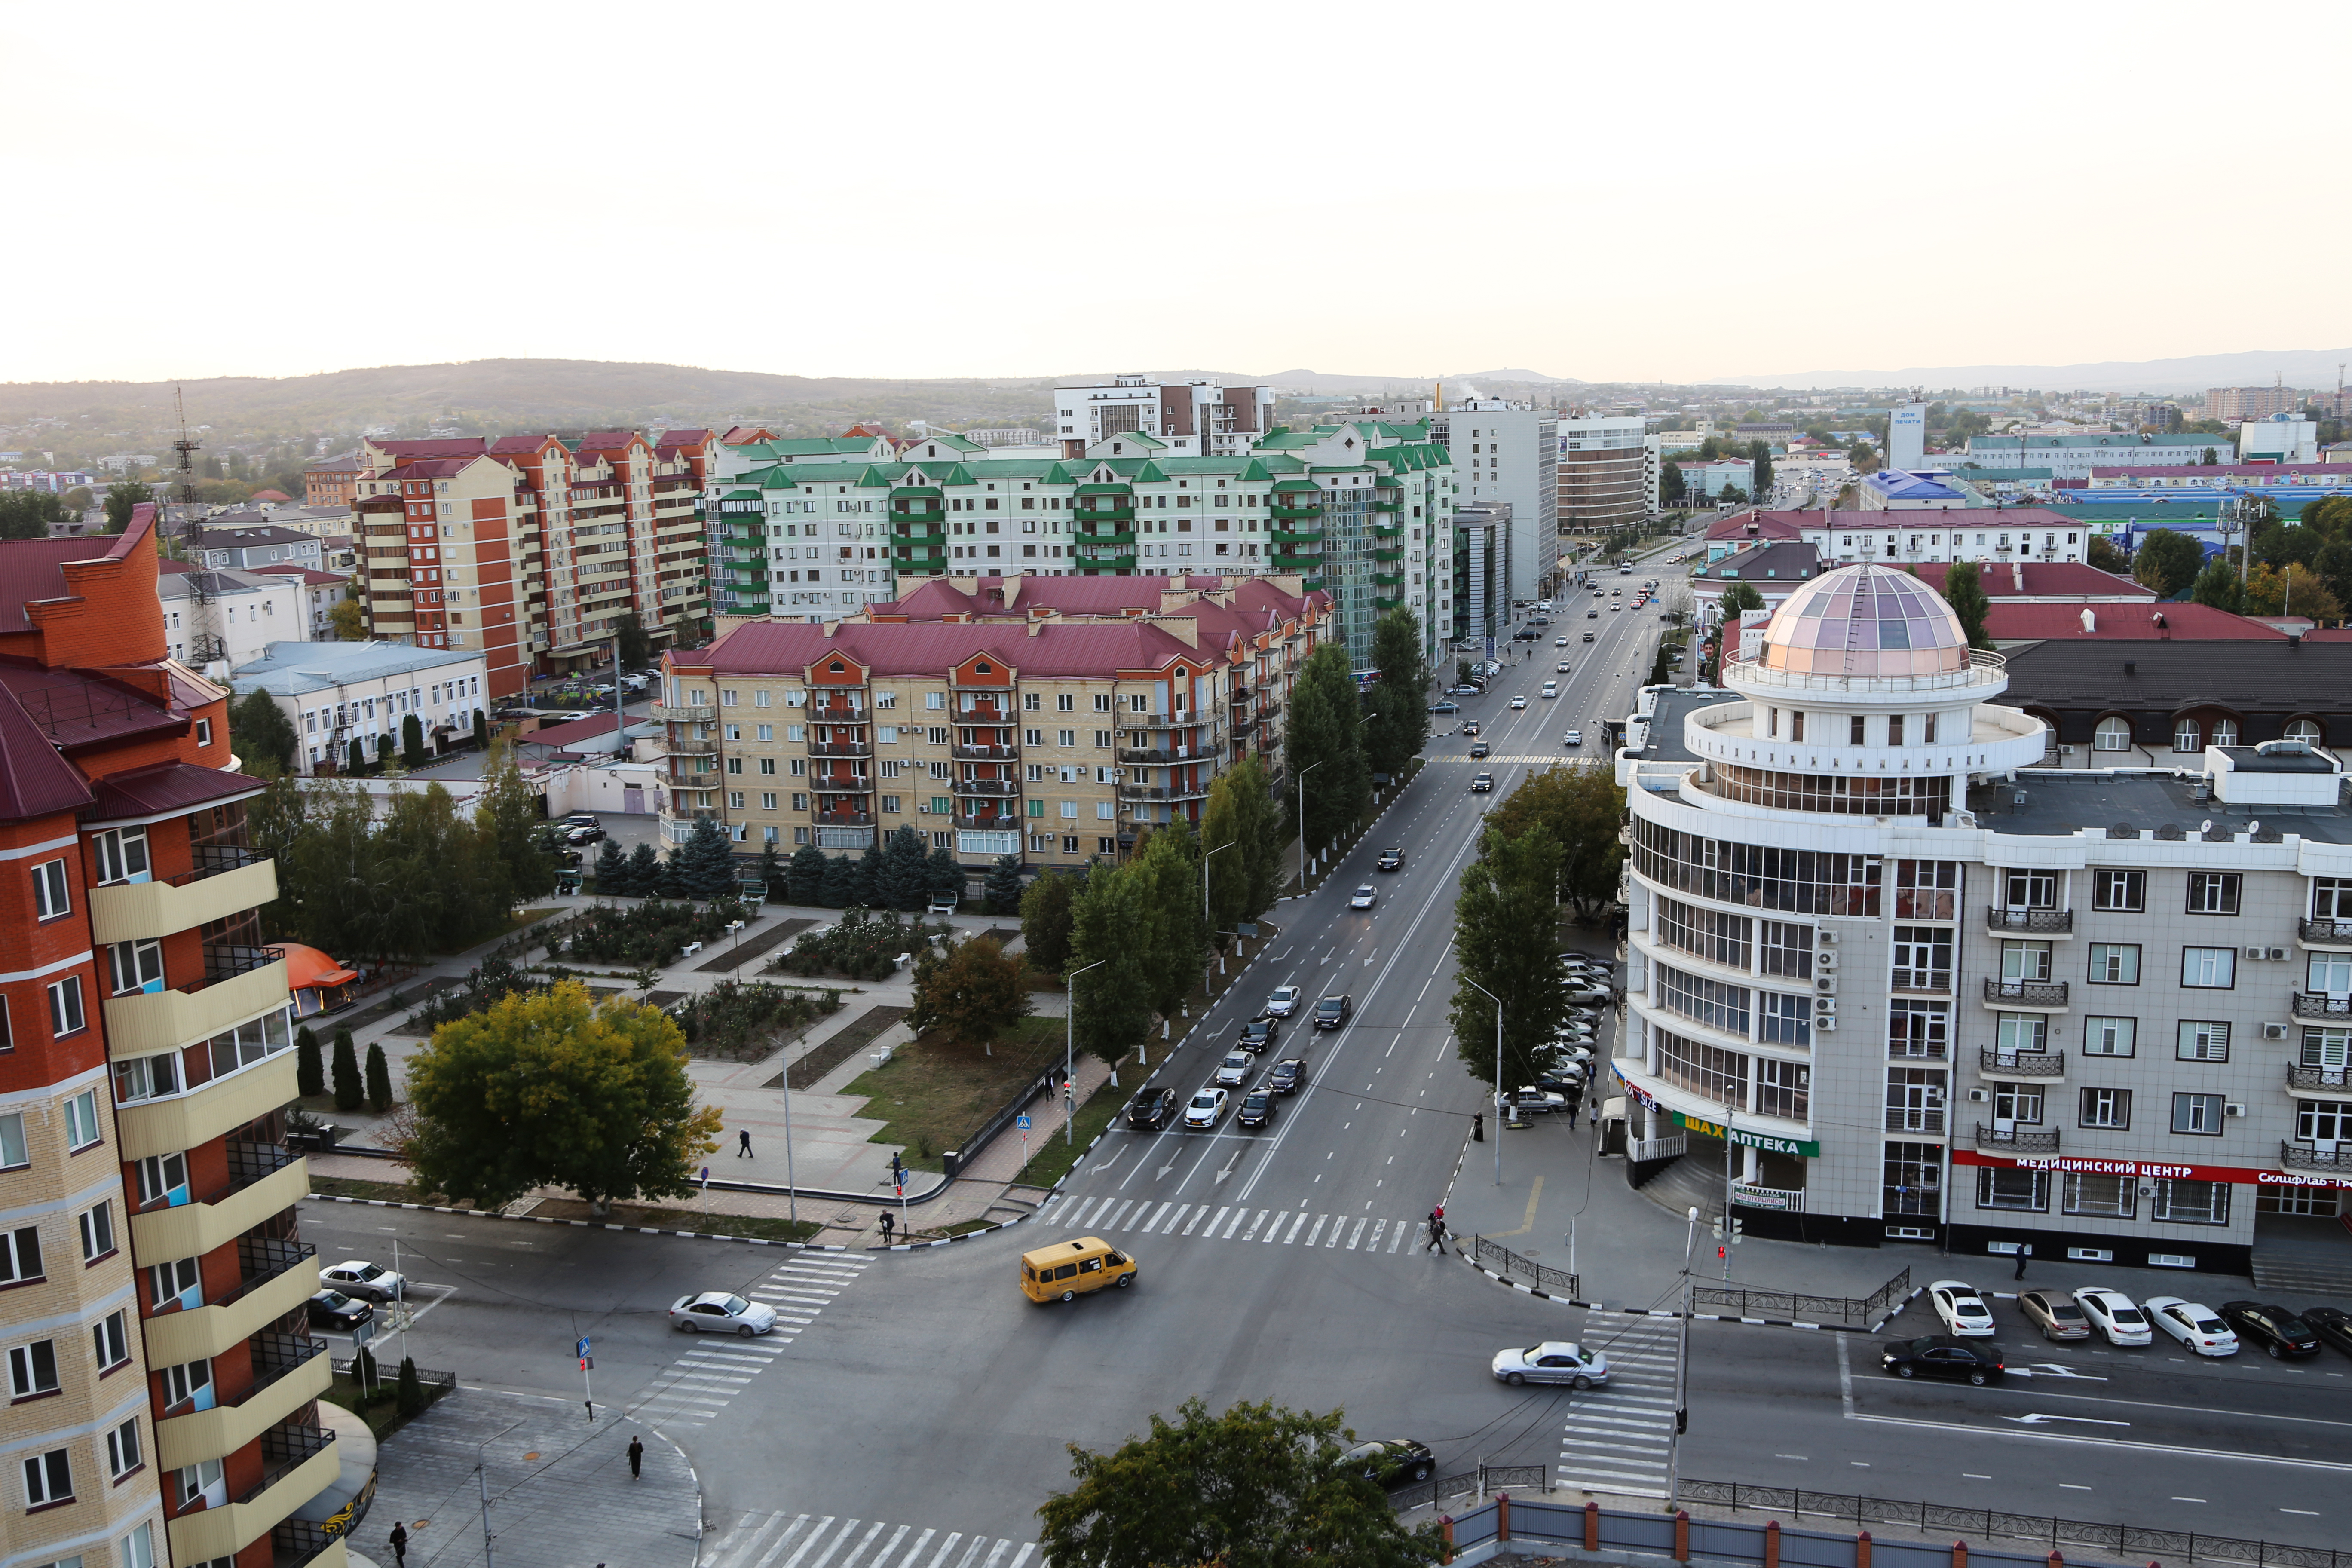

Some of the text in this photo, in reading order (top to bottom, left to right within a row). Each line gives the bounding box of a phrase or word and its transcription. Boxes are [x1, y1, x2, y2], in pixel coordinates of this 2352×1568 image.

[1641, 1094, 1657, 1112] SIZE
[1685, 1115, 1799, 1154] ШАХ АПТЕКА
[2017, 1159, 2192, 1177] МЕДИЦИНСКИЙ ЦЕНТР
